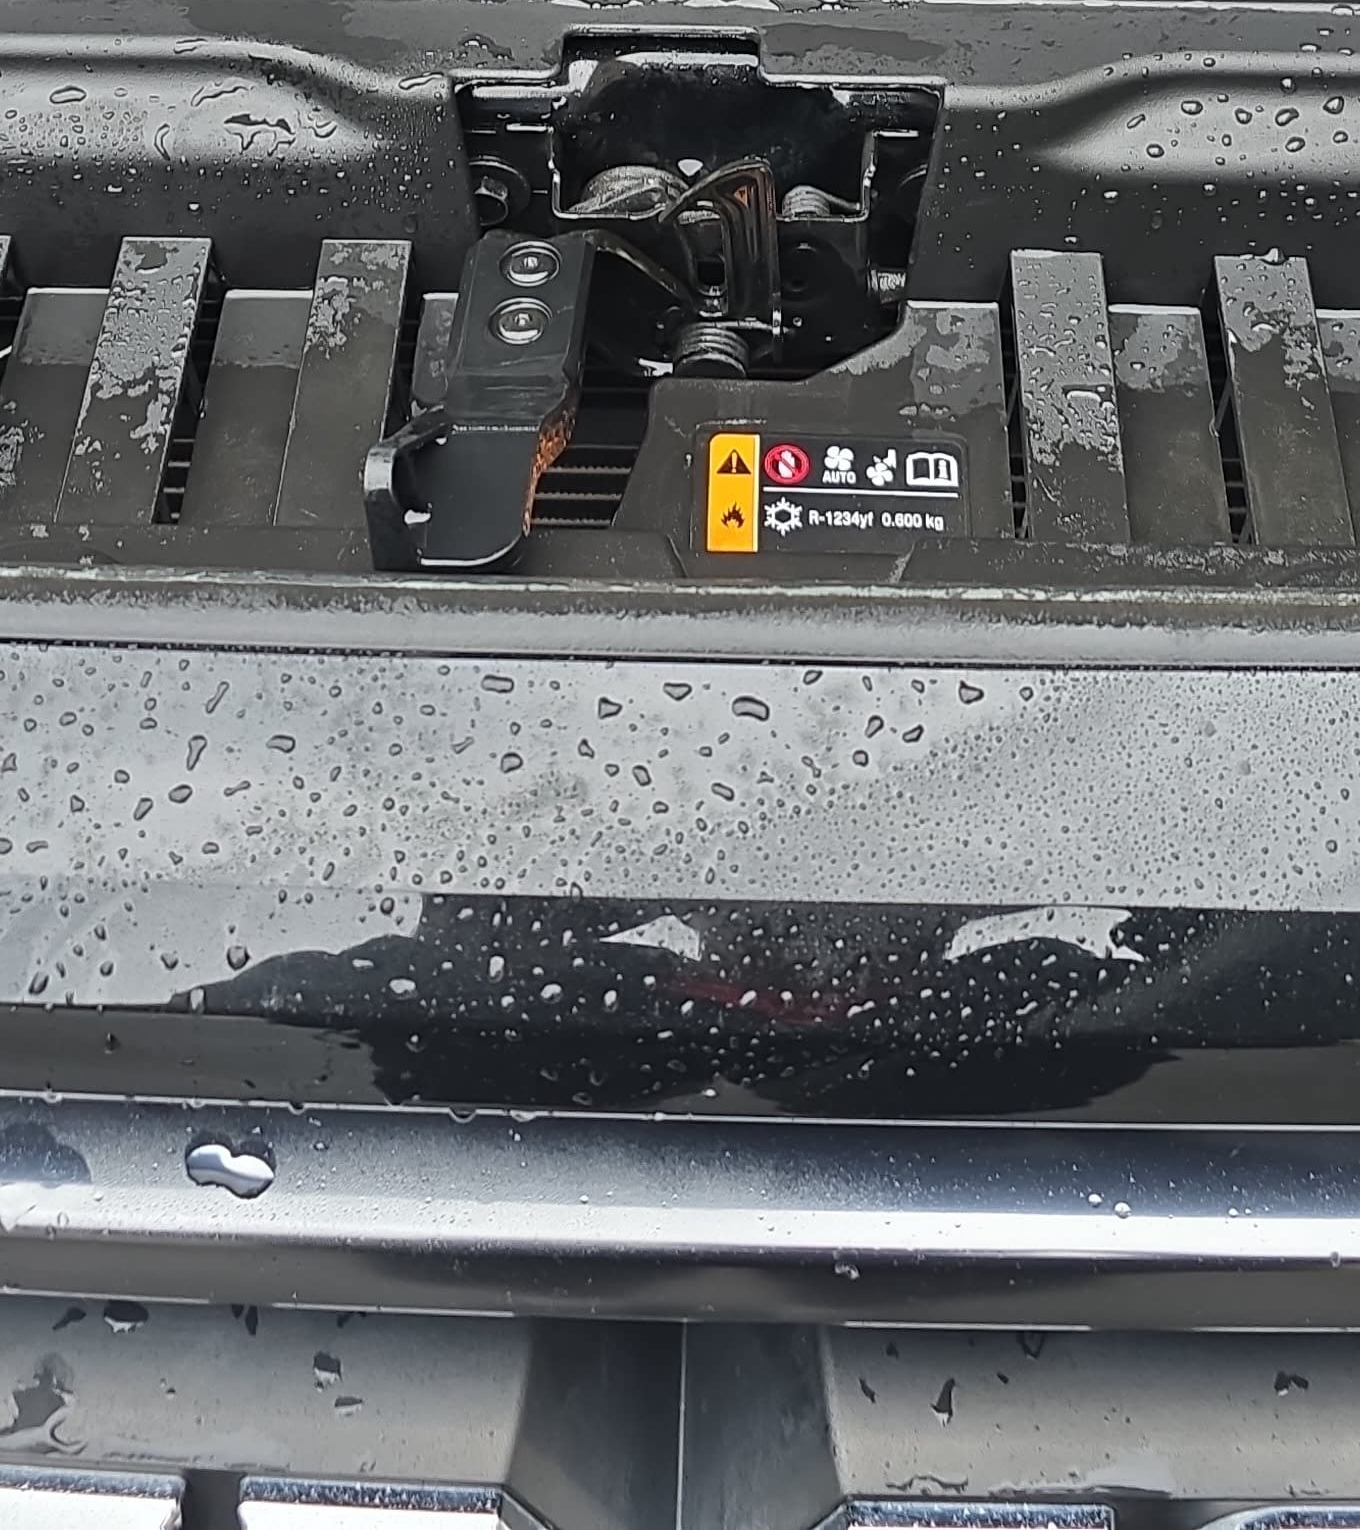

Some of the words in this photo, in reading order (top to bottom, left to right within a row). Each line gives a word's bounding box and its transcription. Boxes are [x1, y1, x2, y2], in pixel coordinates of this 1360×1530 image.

[822, 470, 856, 484] AUTO
[808, 510, 874, 530] R-1234yf
[925, 512, 944, 532] kg
